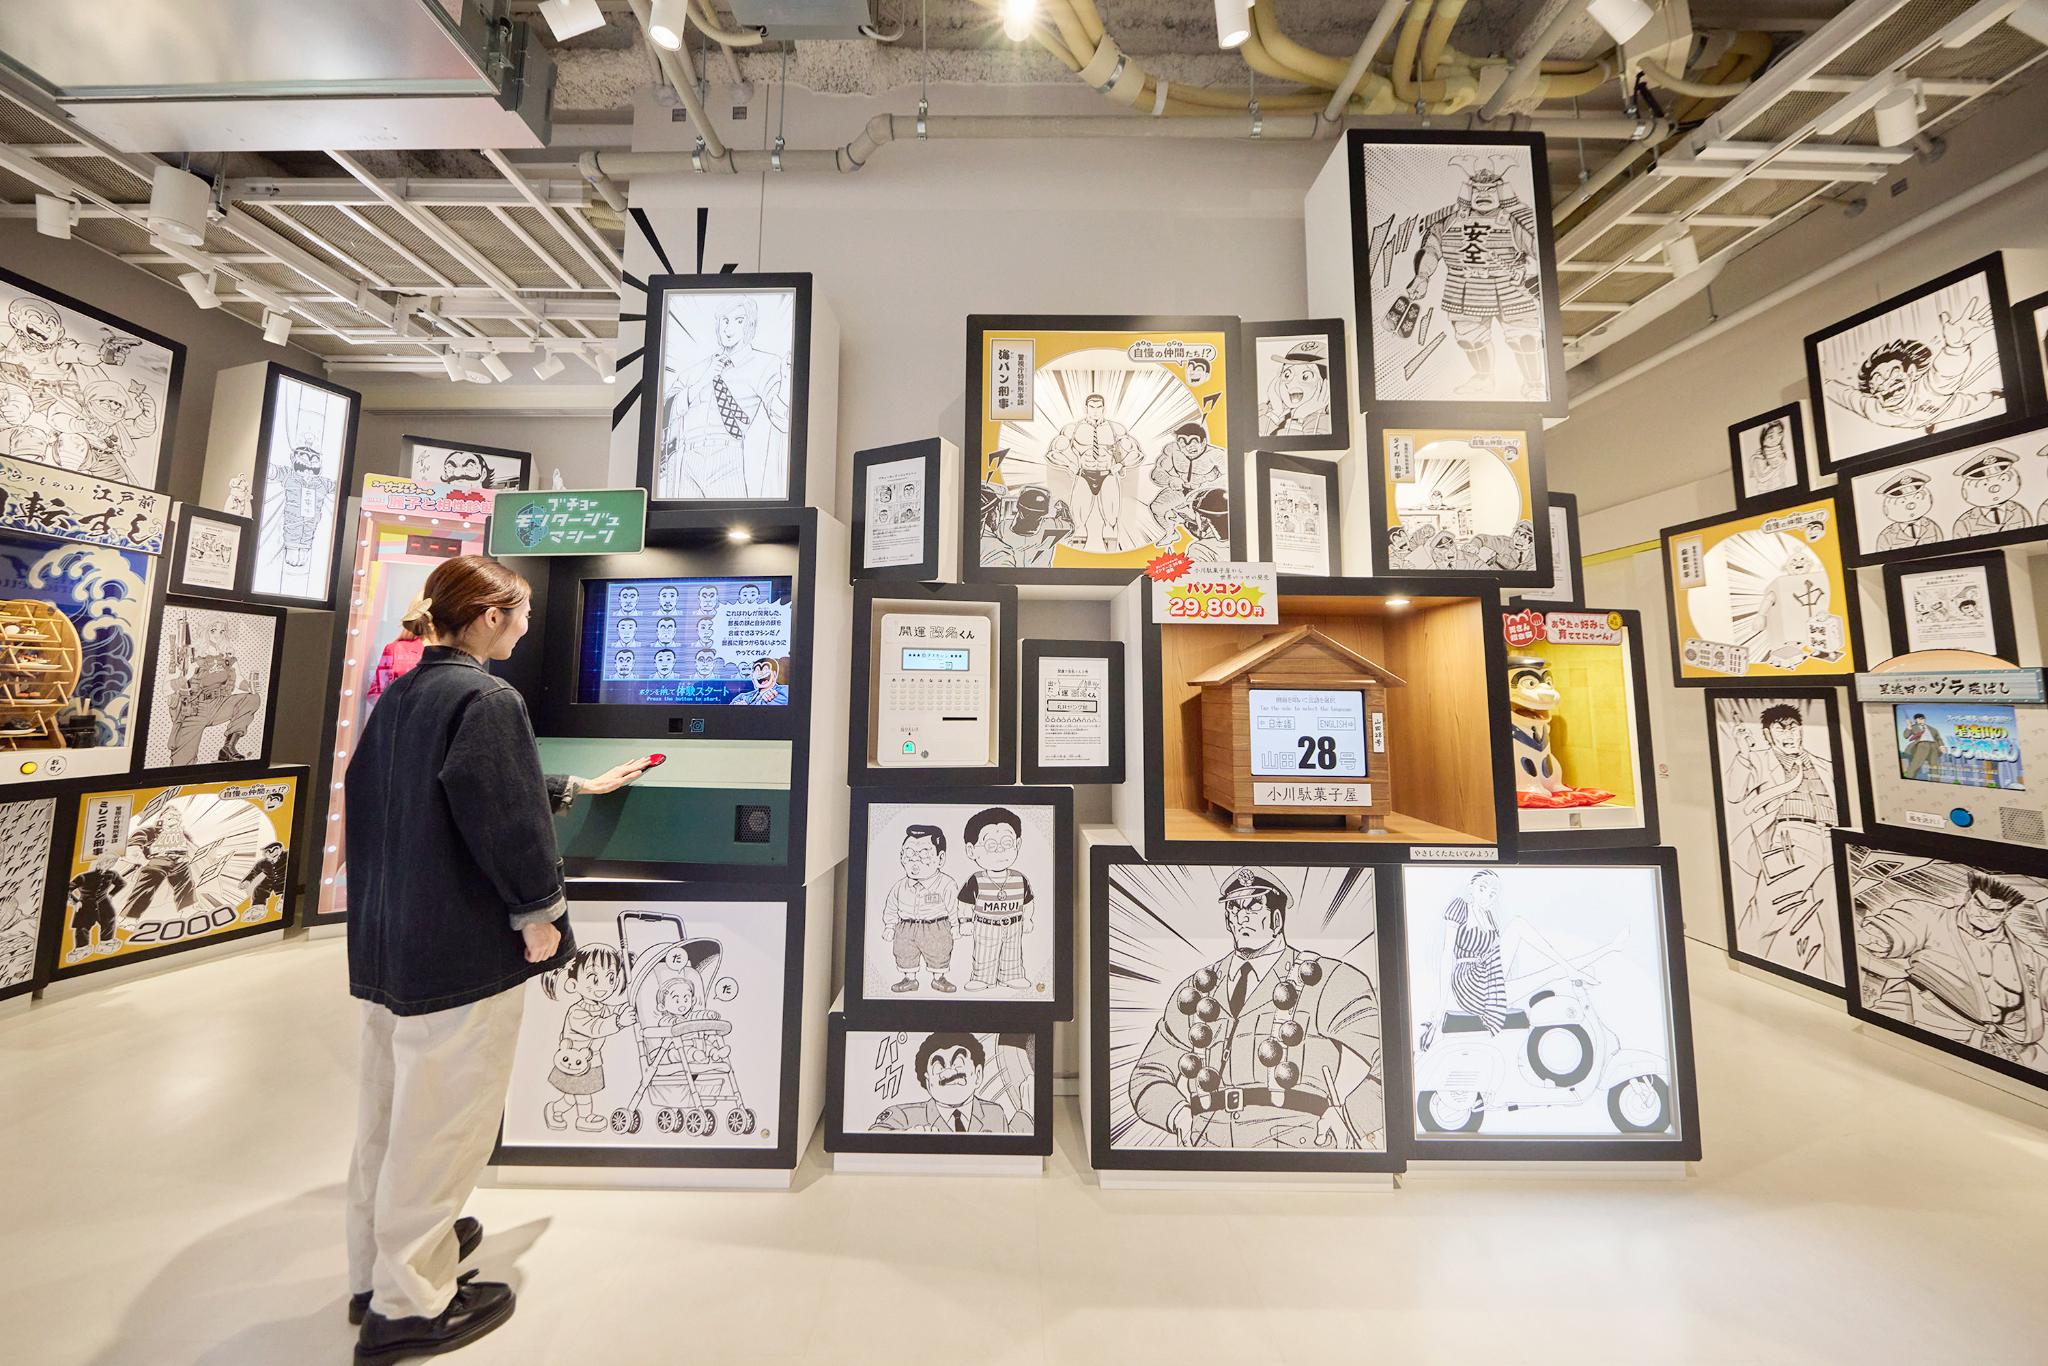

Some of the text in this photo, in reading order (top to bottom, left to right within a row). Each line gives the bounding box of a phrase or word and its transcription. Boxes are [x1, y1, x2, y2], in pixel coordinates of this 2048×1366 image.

[1462, 221, 1493, 266] 安全
[998, 349, 1010, 409] 海パン刑事
[93, 484, 157, 513] 江戸前
[548, 498, 600, 511] ブチョー
[0, 487, 160, 545] 転ずし
[515, 512, 620, 527] モンタージュ
[550, 530, 615, 543] マシーン
[1187, 582, 1241, 594] パソコン
[1169, 597, 1264, 618] 29,800円
[1268, 719, 1292, 729] 日本語
[1320, 719, 1348, 729] ENGLISH
[1267, 786, 1359, 802] 小川駄菓子屋
[1414, 849, 1496, 857] やさしくたたいてみよう!
[983, 901, 1019, 911] MARUI
[129, 906, 236, 942] 2000
[672, 953, 682, 965] だ
[721, 983, 733, 995] だ
